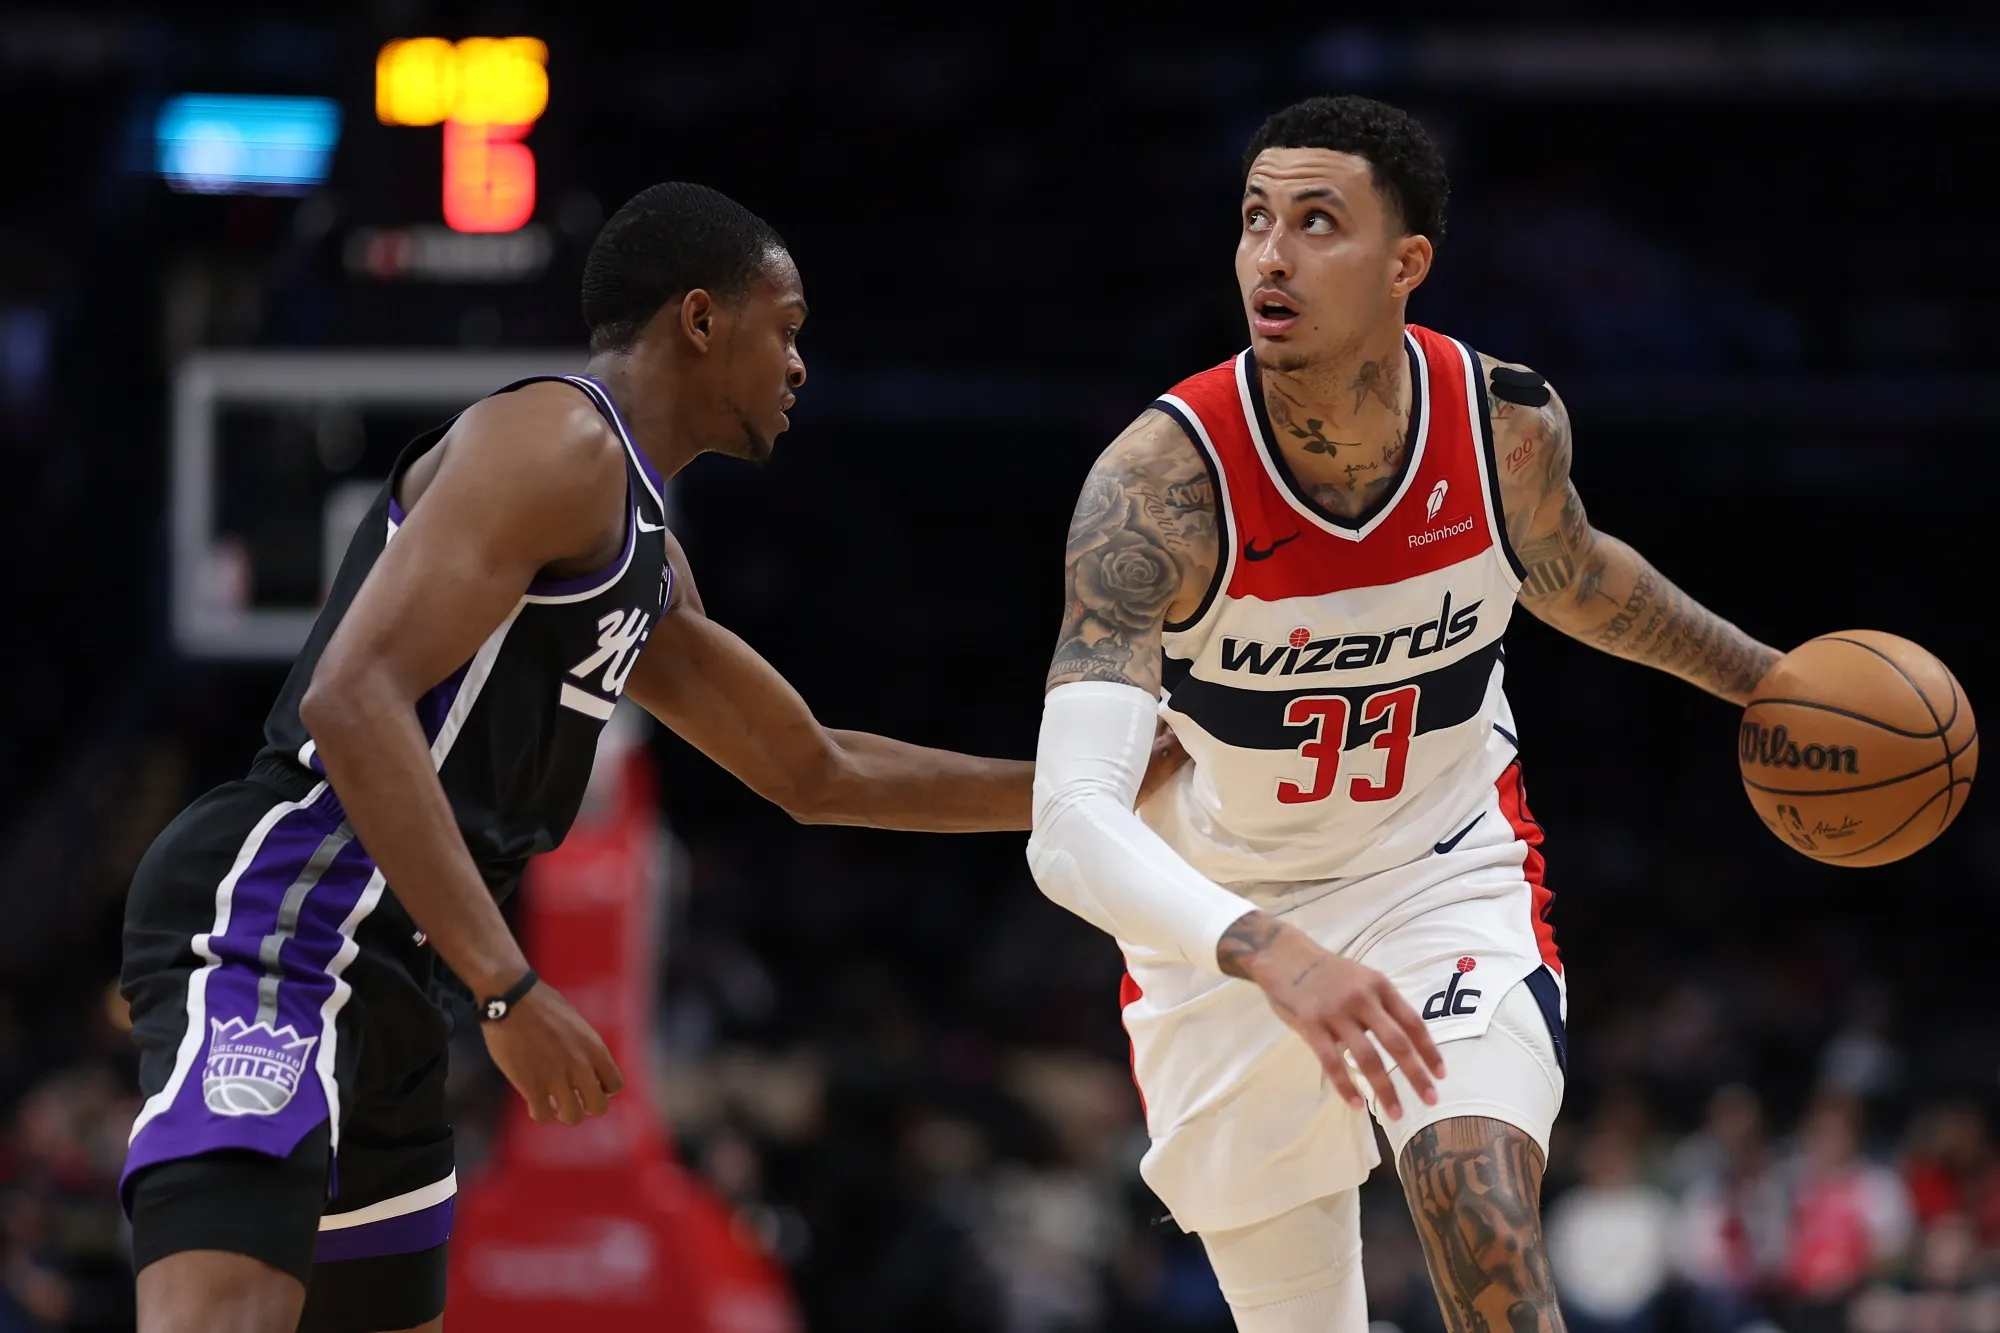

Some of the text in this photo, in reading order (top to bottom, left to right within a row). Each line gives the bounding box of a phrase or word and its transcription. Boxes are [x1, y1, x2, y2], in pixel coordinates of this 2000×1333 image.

[1505, 438, 1533, 472] 100
[1408, 516, 1474, 548] Robinhood
[1221, 590, 1484, 676] wizards
[1276, 684, 1420, 804] 33
[1741, 722, 1859, 774] Wilson
[1422, 972, 1482, 1020] dc
[206, 1056, 298, 1093] KINGS
[211, 1043, 300, 1069] SACRAMENTO
